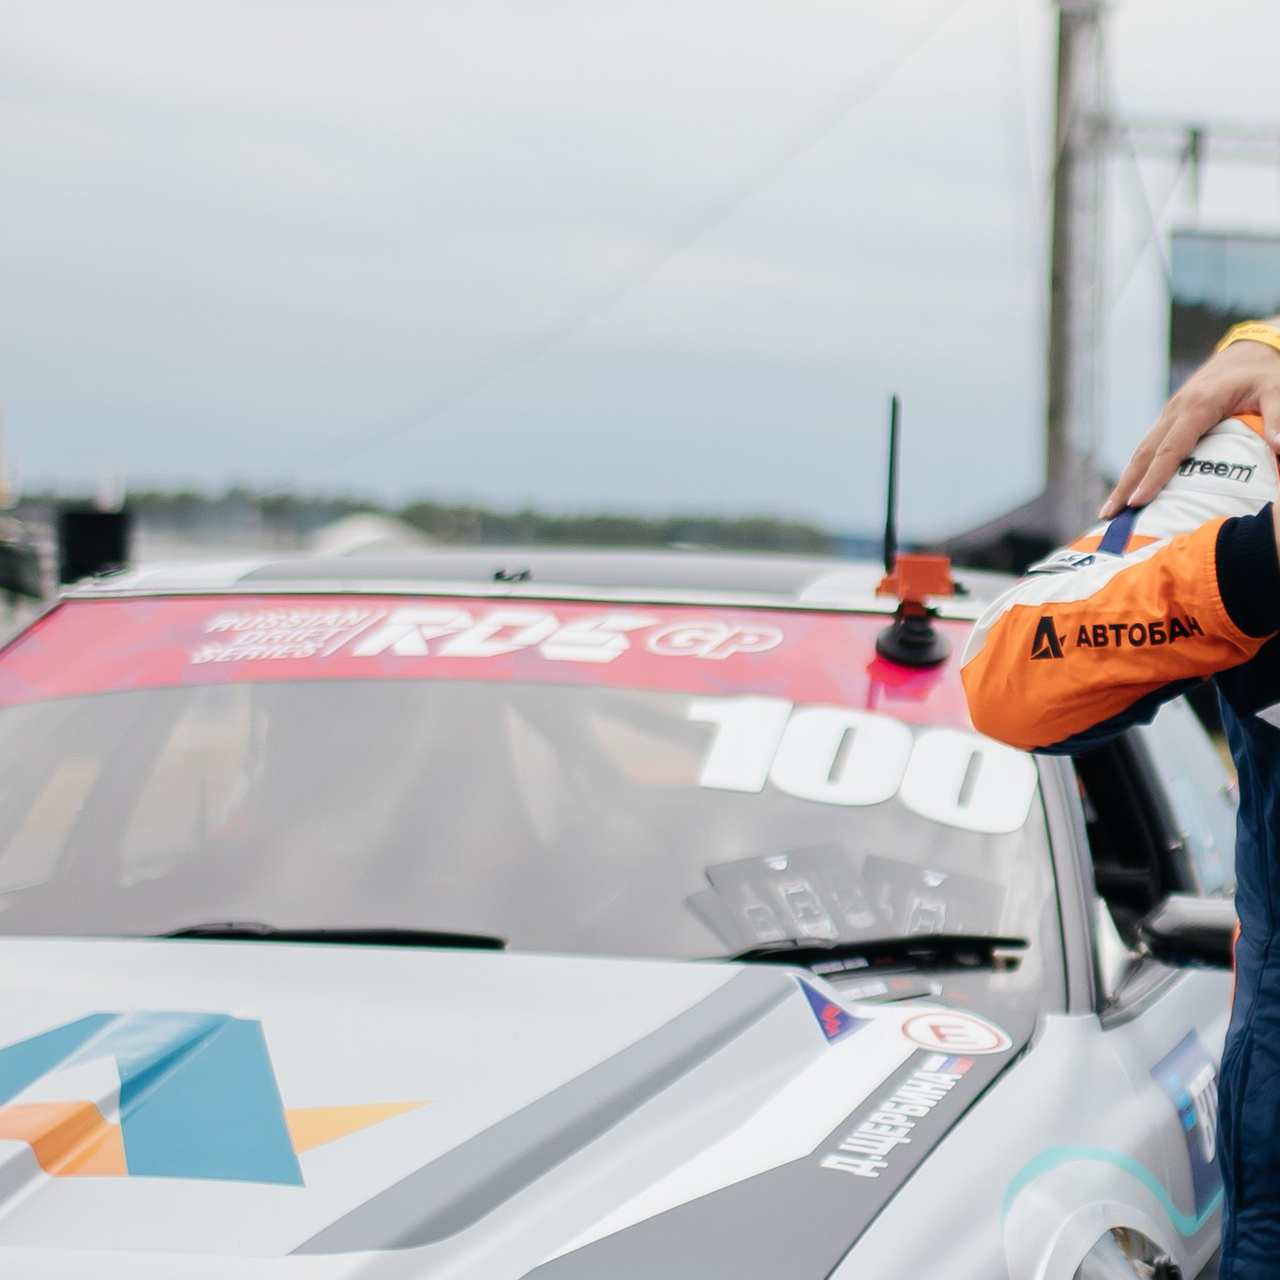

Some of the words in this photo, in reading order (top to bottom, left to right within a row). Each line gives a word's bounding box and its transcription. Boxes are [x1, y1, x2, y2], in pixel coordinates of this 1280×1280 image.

[1179, 456, 1256, 484] freem
[350, 607, 662, 663] RDS
[647, 620, 785, 660] GP
[1076, 615, 1205, 648] АВТОБАН
[689, 696, 1038, 835] 100
